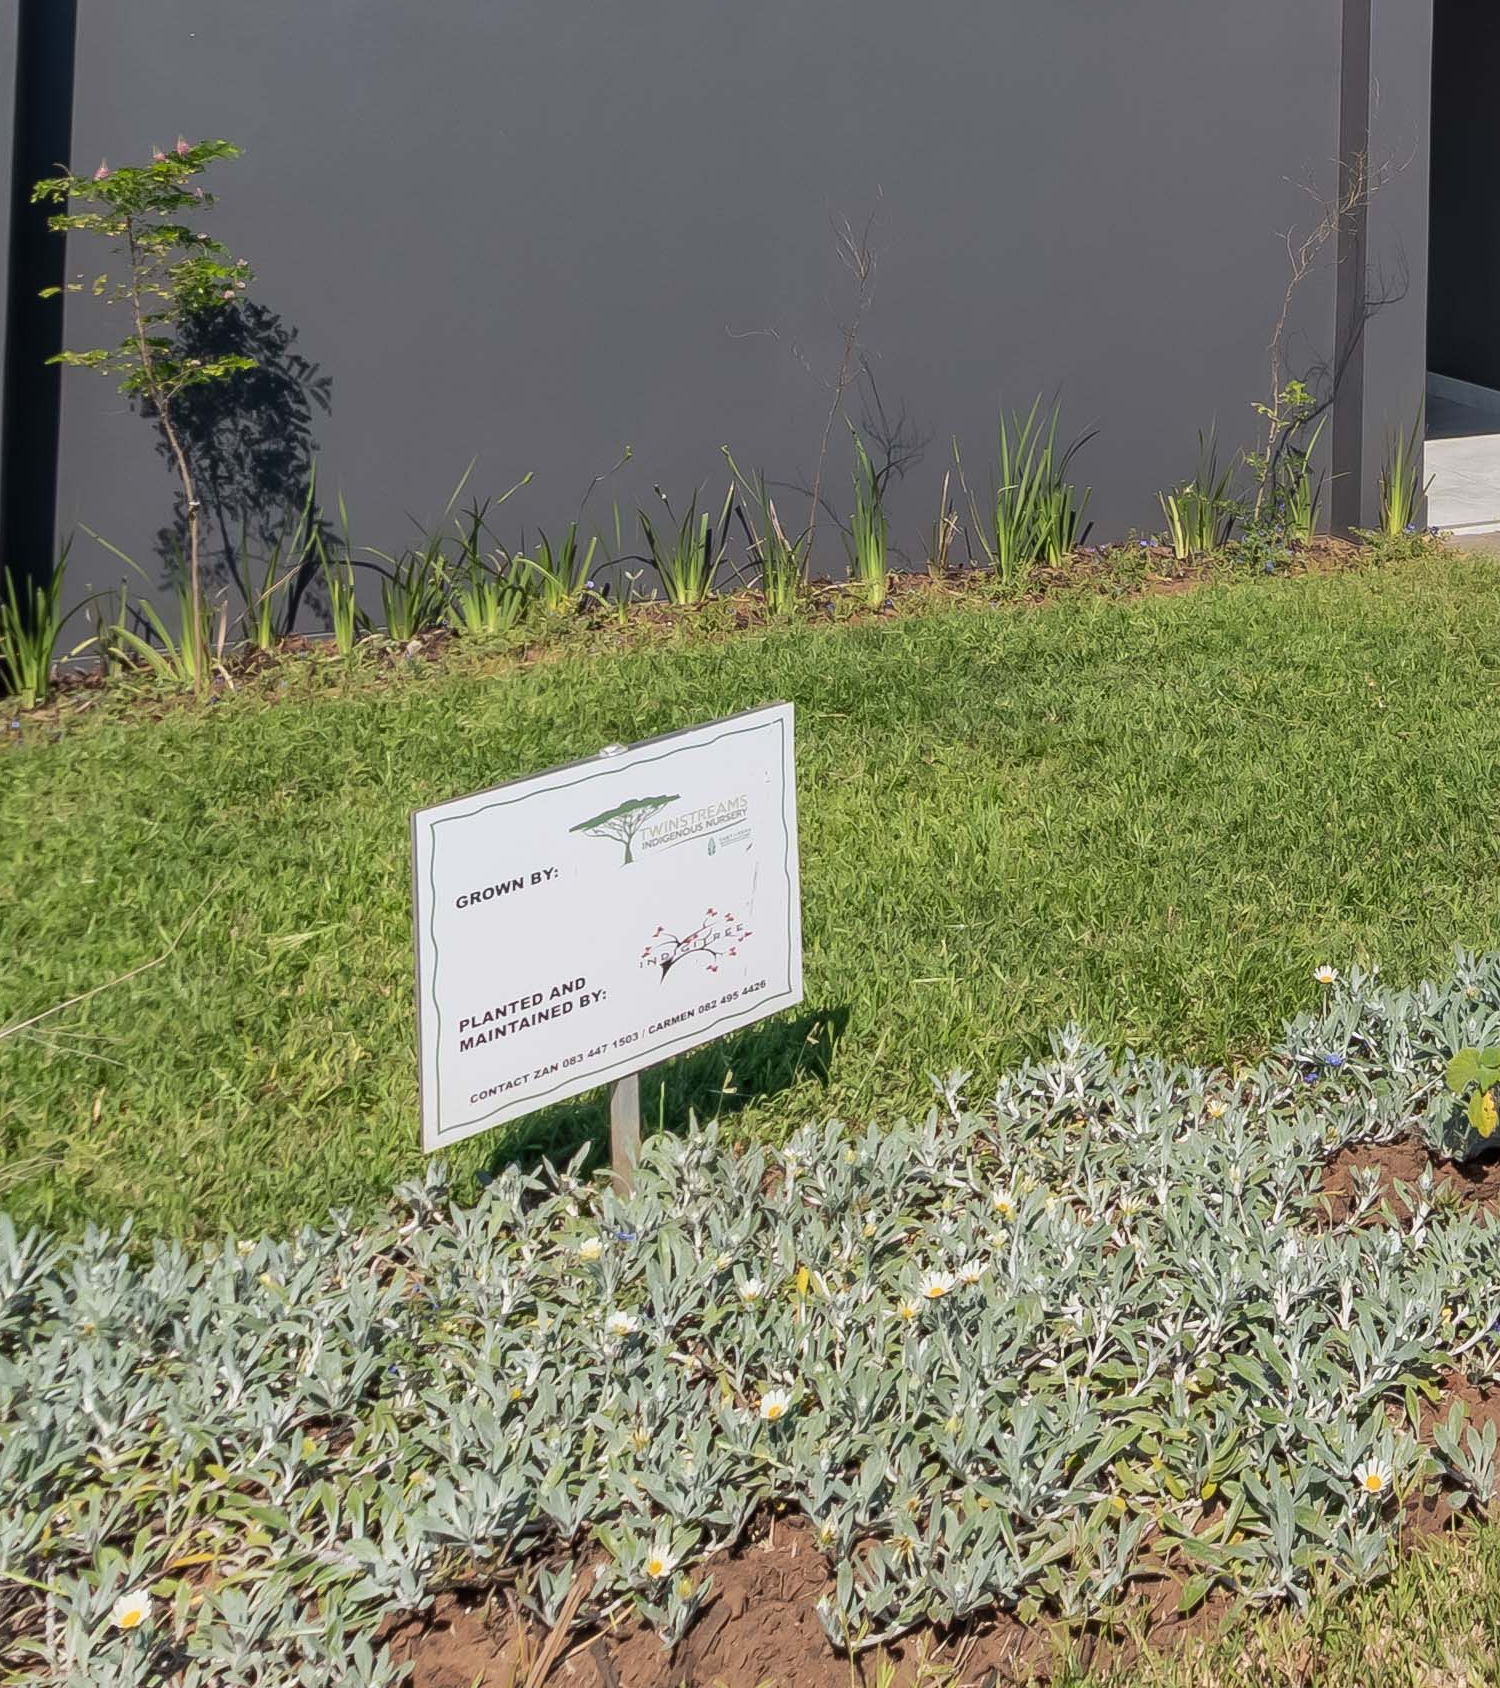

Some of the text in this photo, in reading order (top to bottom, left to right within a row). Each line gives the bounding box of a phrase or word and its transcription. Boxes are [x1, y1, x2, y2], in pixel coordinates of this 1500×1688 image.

[640, 794, 748, 840] TWINSTREAMS
[642, 823, 704, 850] INDIGENOUS
[706, 807, 748, 828] NURSERY
[455, 866, 559, 909] GROWN BY:
[458, 977, 587, 1033] PLANTED AND
[458, 988, 608, 1053] MAINTAINED BY:
[469, 1073, 531, 1105] CONTACT
[532, 1062, 560, 1080] ZAN
[561, 1053, 585, 1069] 083
[587, 1043, 609, 1058] 447
[612, 1031, 640, 1049] 1503
[648, 1008, 696, 1035] CARMEN
[697, 999, 718, 1014] 082
[720, 990, 740, 1005] 495
[741, 979, 767, 996] 4426
